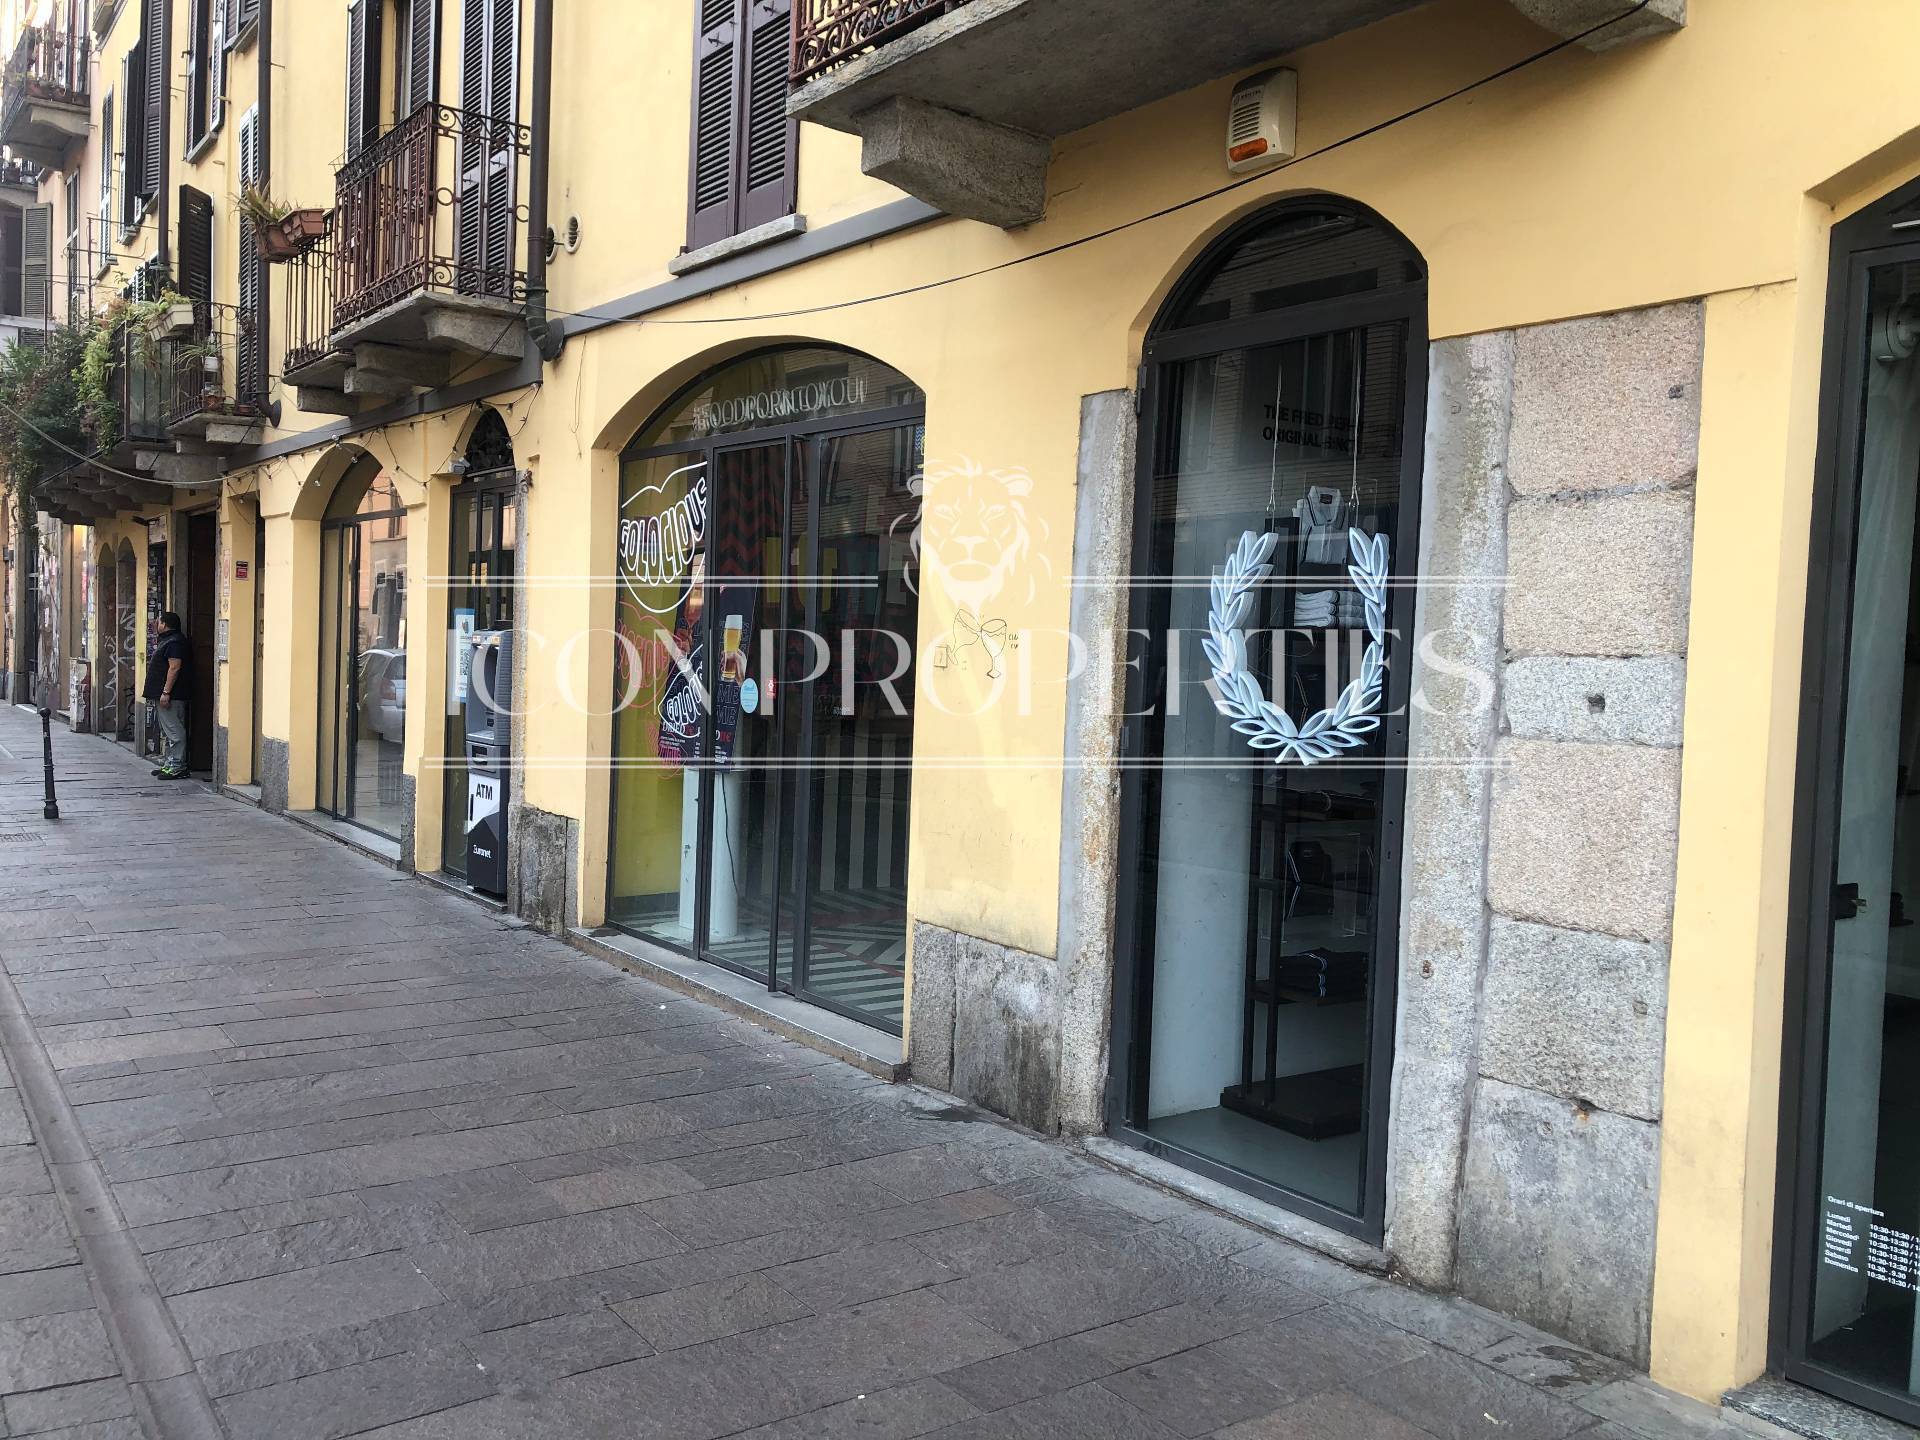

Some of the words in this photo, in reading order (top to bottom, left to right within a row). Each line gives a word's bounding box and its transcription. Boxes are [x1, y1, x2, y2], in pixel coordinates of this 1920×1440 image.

[476, 783, 493, 800] ATM
[473, 844, 492, 858] Euronet
[1827, 1195, 1846, 1206] Orari
[1846, 1200, 1854, 1209] di
[1854, 1204, 1885, 1217] apertura
[1824, 1249, 1849, 1262] Sabato
[1824, 1256, 1859, 1273] Domenica
